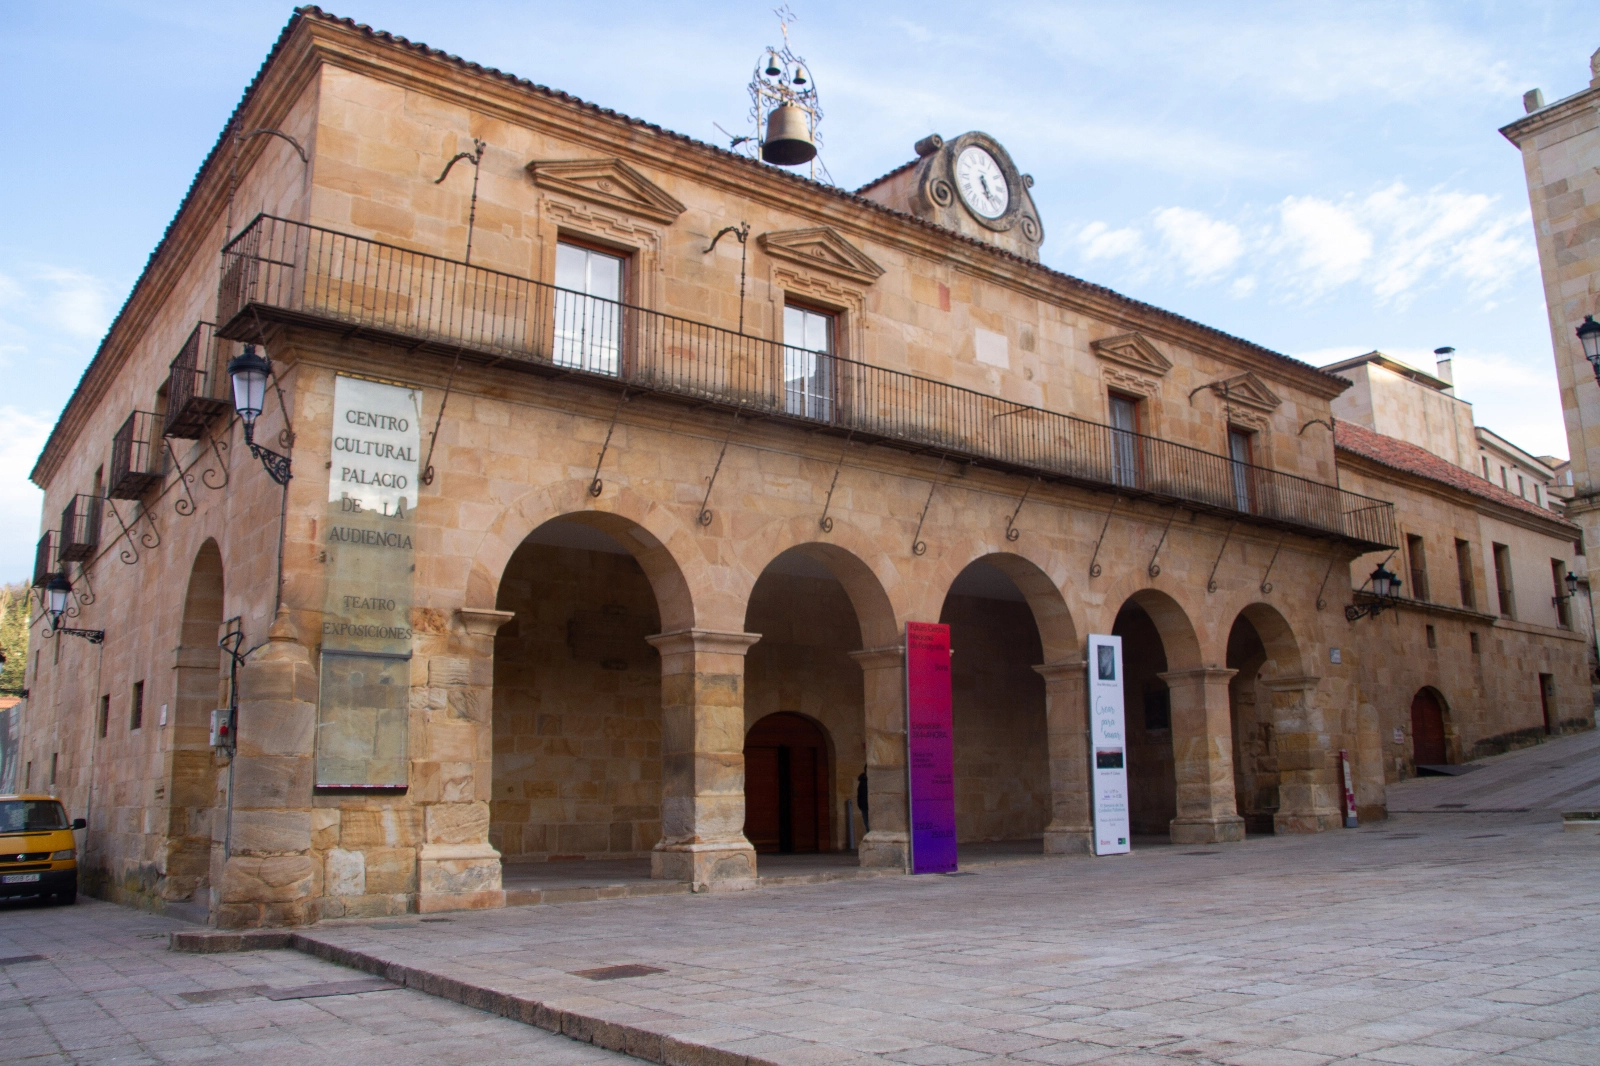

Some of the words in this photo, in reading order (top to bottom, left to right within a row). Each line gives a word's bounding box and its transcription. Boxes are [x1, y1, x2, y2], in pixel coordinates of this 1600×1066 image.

[346, 410, 408, 432] CENTRO
[334, 437, 416, 462] CULTURAL
[341, 468, 407, 489] PALACIO
[342, 497, 362, 513] DE
[383, 502, 404, 518] LA
[329, 526, 413, 549] AUDIENCIA
[344, 596, 395, 611] TEATRO
[322, 622, 412, 640] EXPOSICIONES
